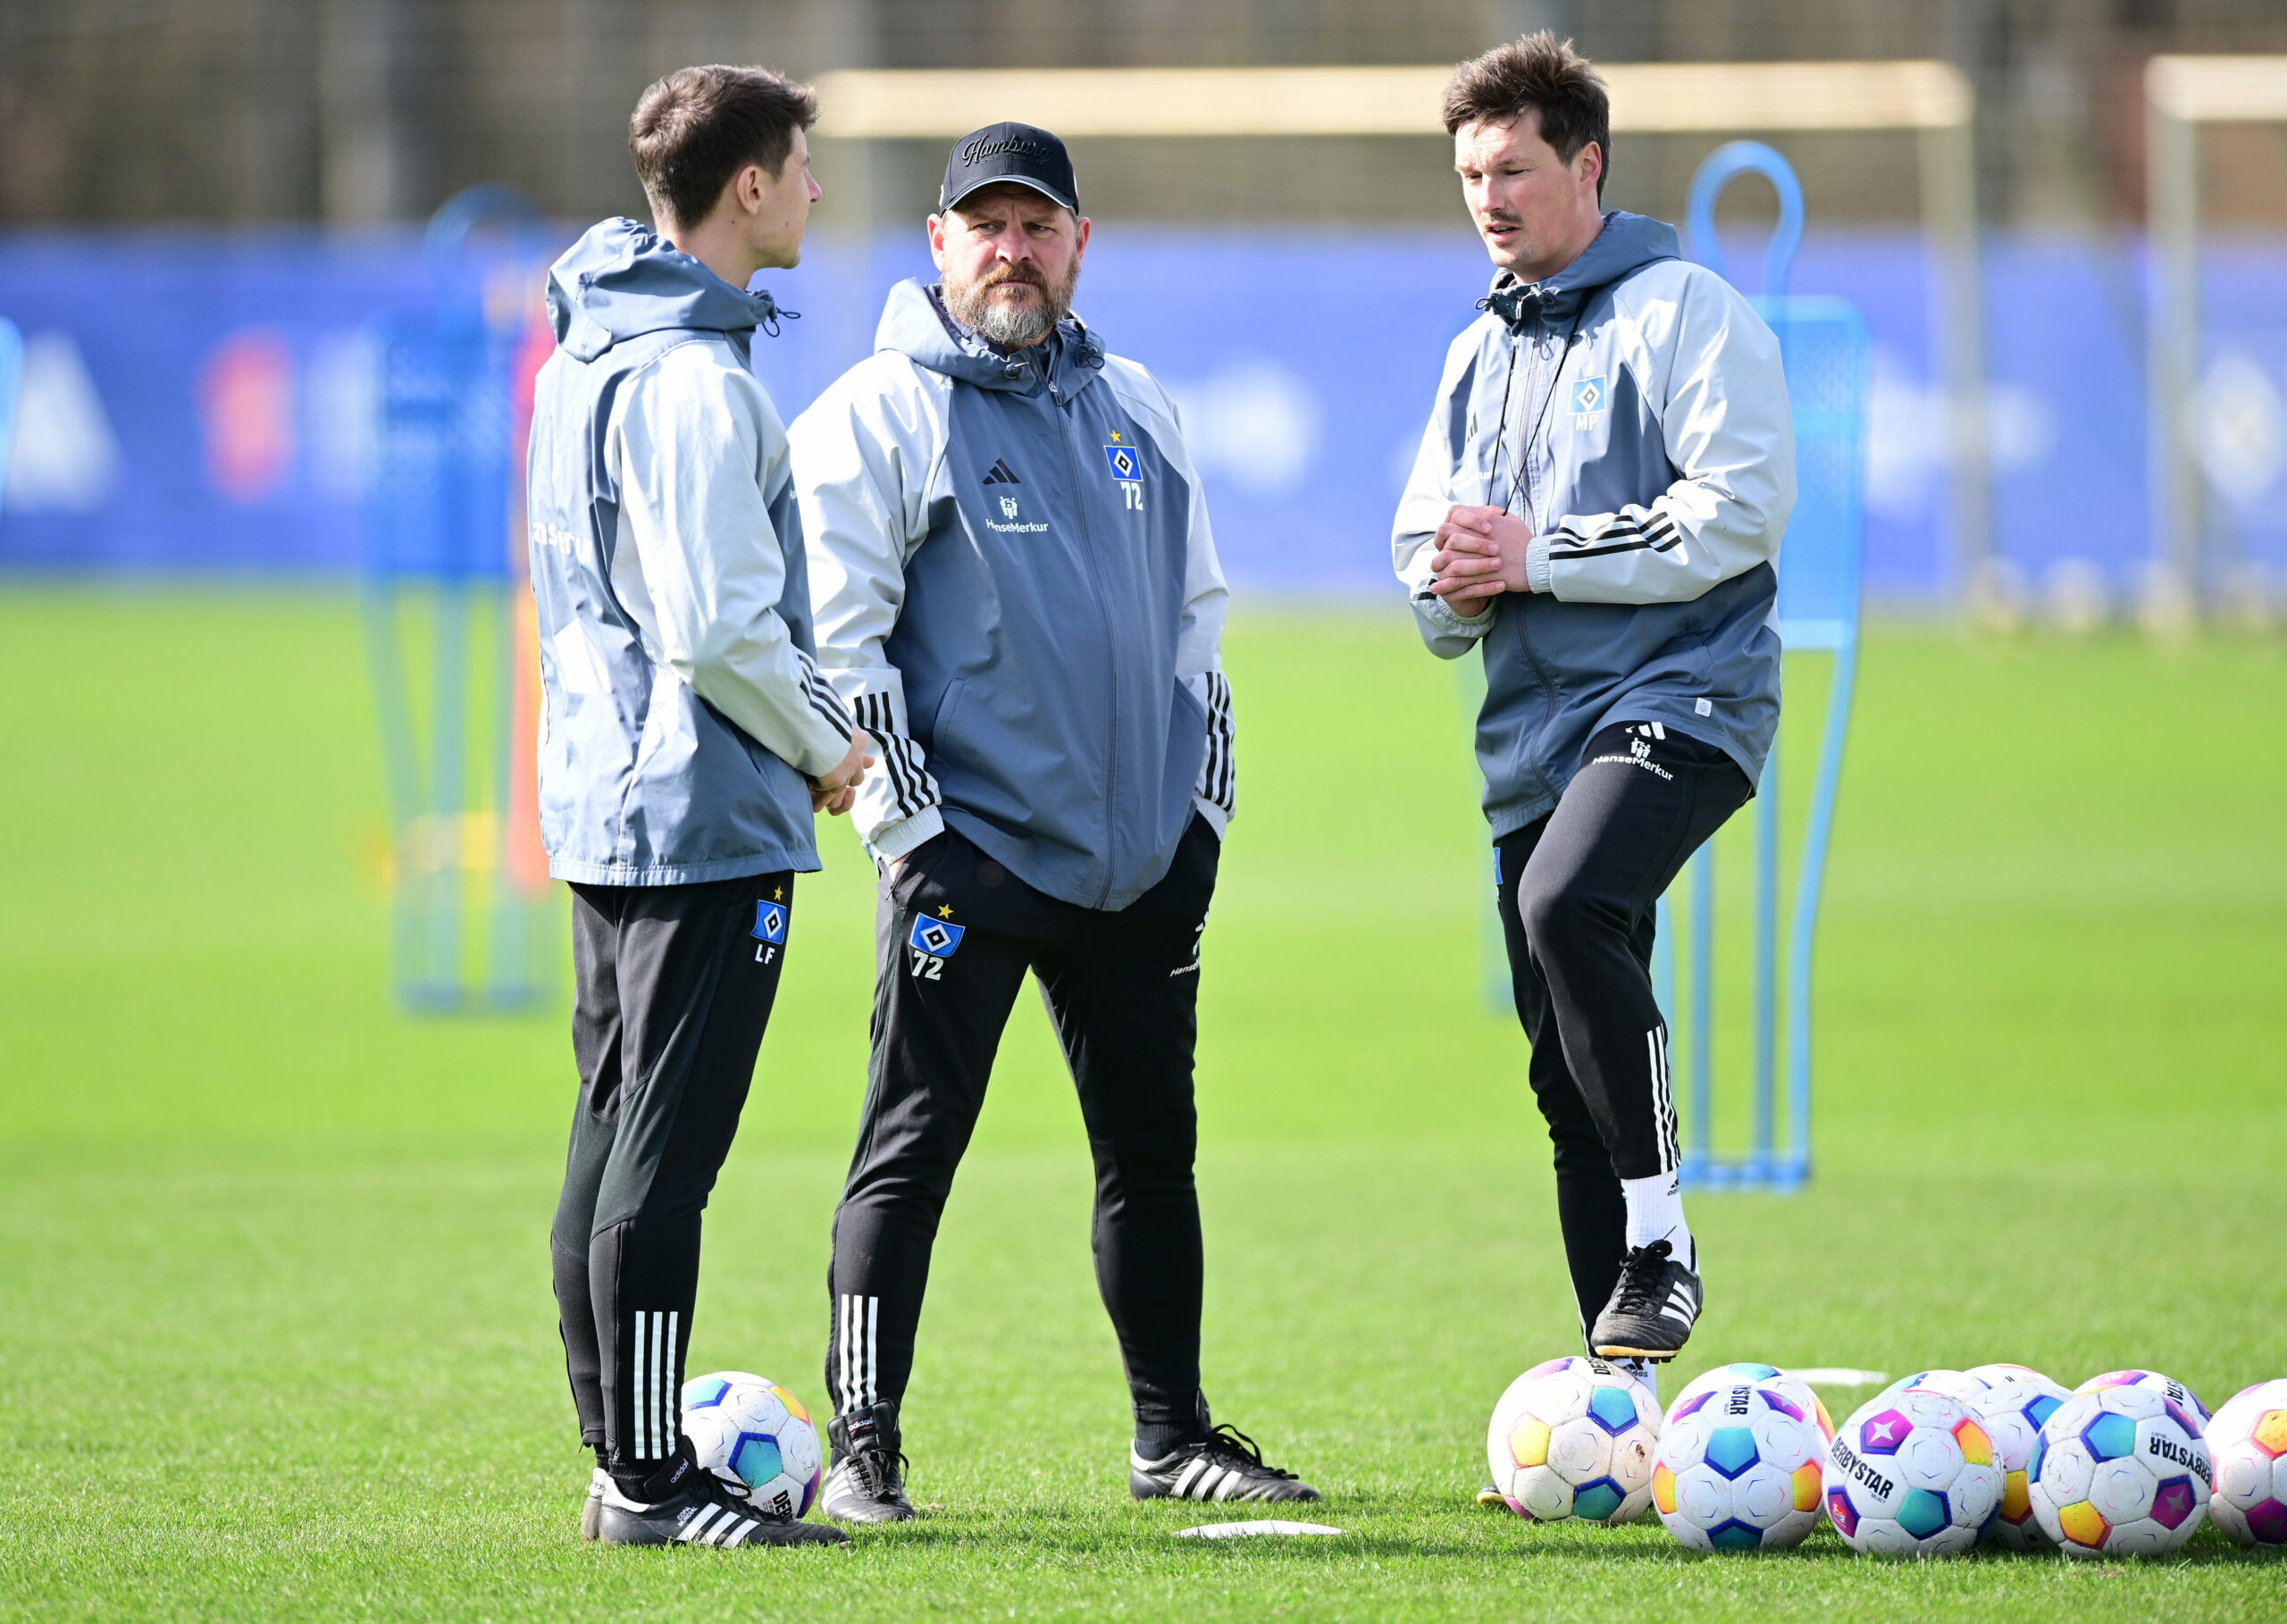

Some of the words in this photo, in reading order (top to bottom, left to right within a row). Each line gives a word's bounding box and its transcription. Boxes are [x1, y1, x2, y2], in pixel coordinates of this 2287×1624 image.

[962, 135, 1051, 167] Hamburg
[1575, 414, 1597, 431] MP
[1121, 481, 1144, 511] 72
[985, 519, 1049, 533] HnseMerkur
[1592, 755, 1673, 781] HanseMerkur
[754, 943, 775, 965] LF
[911, 950, 944, 981] 72
[1831, 1436, 1894, 1500] DERBYSTAR
[2149, 1436, 2214, 1491] DERBYSTAR
